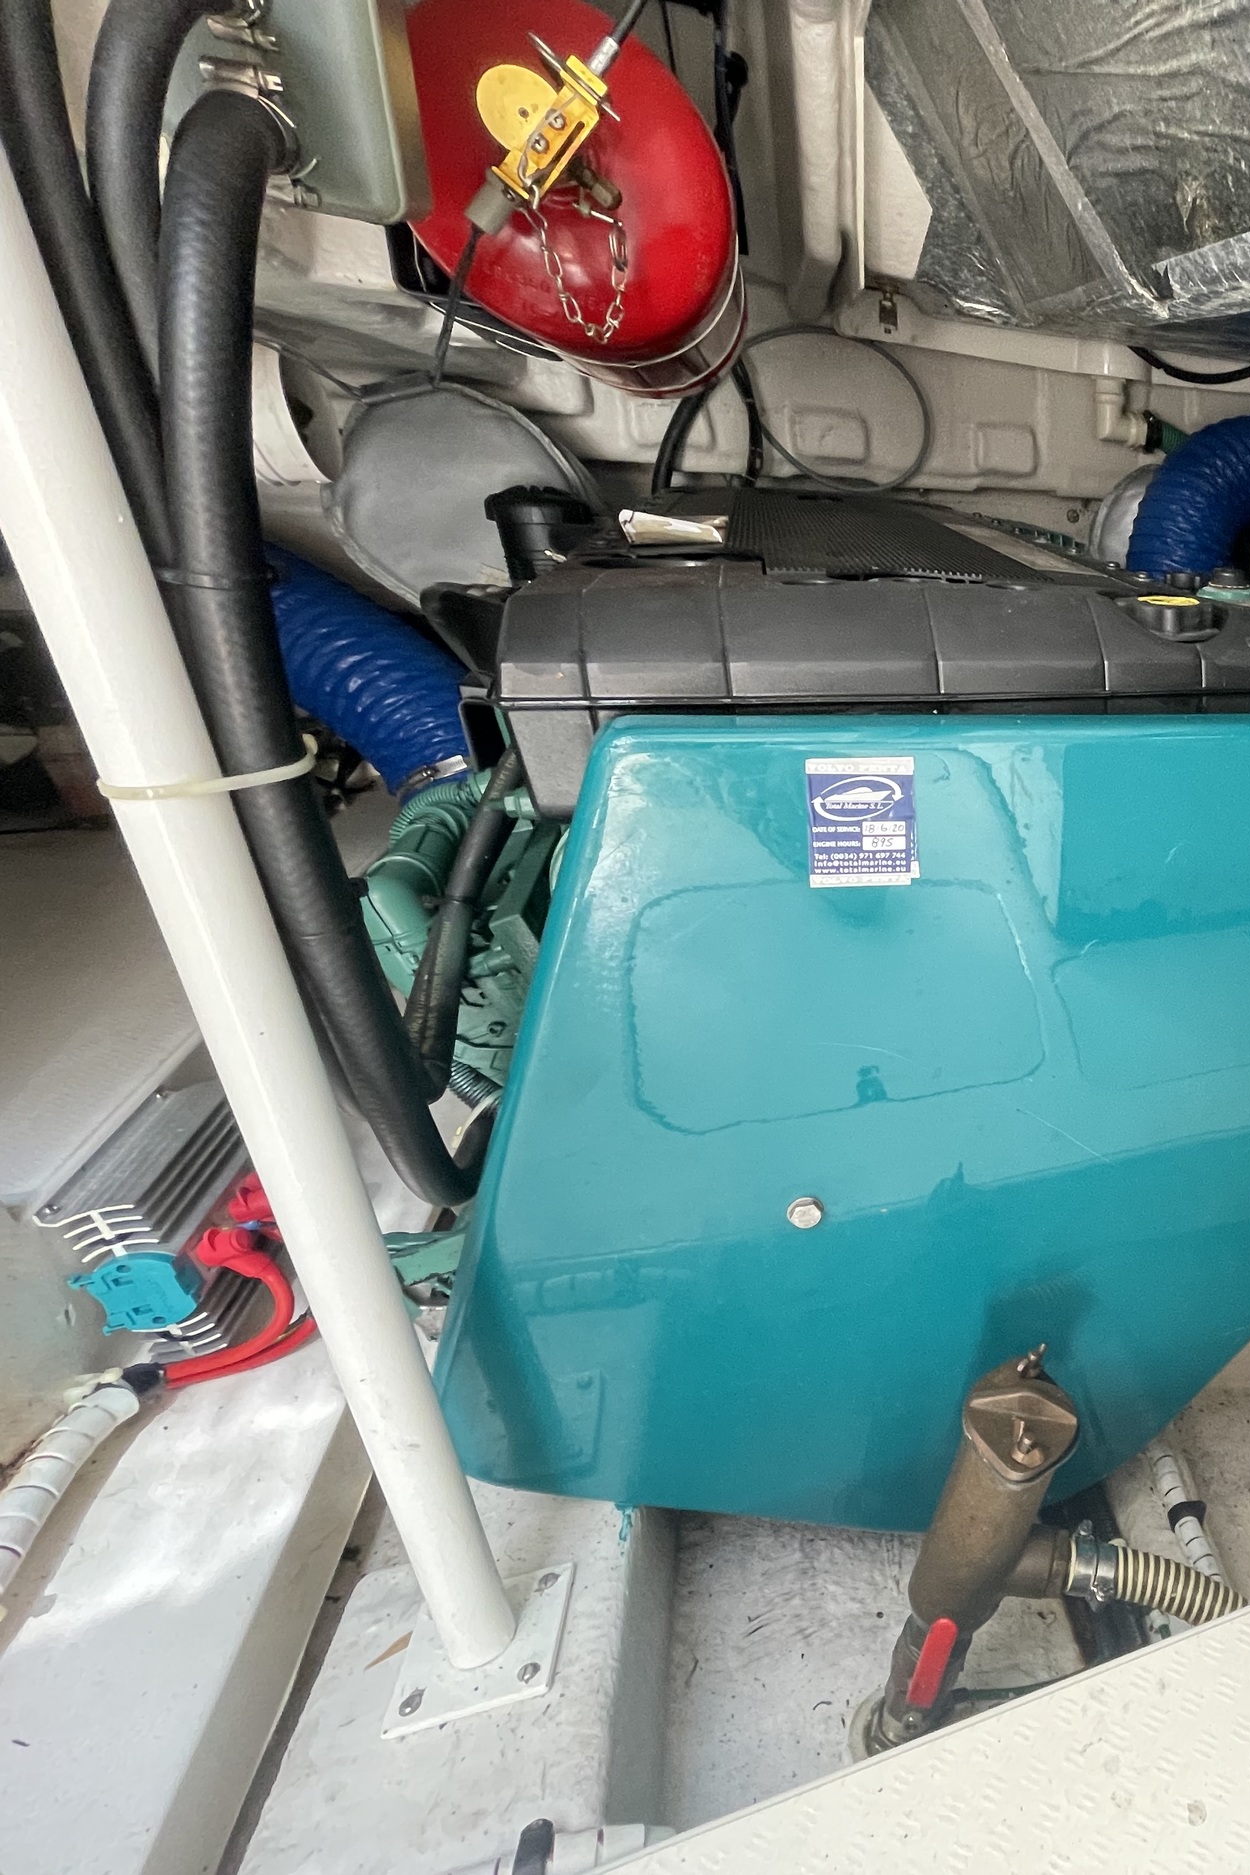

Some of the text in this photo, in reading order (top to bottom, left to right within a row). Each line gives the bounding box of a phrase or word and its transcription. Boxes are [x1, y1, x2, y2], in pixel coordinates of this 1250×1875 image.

[808, 763, 908, 772] VOLVO PENTA
[825, 802, 842, 810] Total
[843, 802, 868, 810] Marine
[830, 852, 857, 861] (0034)
[859, 852, 873, 860] 971
[813, 875, 909, 885] VOLVO PENTA
